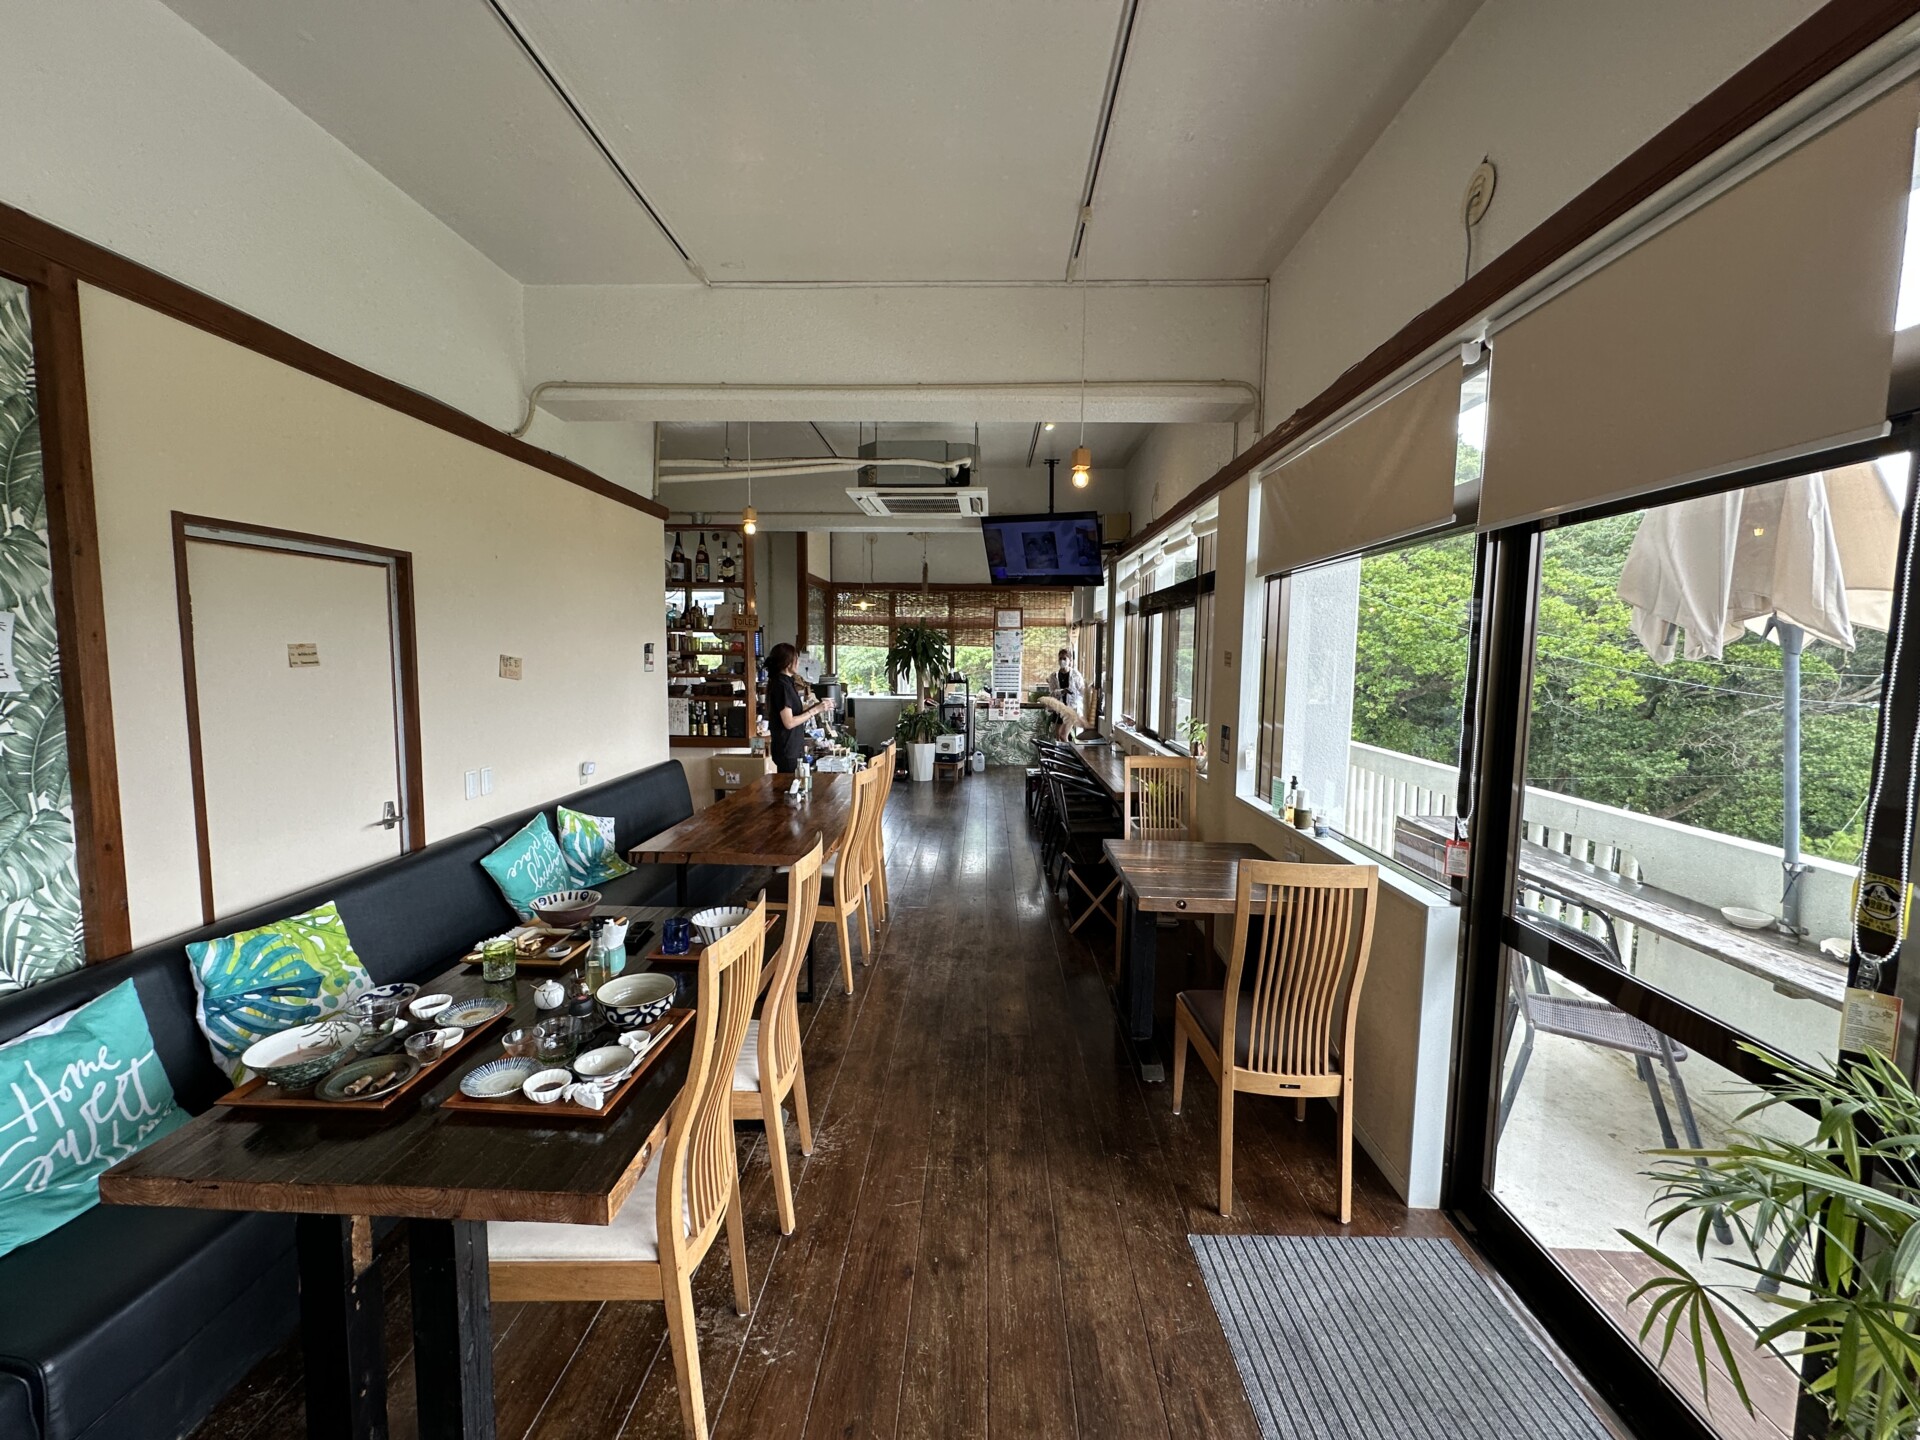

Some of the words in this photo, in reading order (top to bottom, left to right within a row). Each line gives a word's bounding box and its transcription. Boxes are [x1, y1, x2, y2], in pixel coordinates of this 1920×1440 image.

[732, 617, 757, 628] TOILET
[506, 831, 542, 880] place
[0, 1045, 122, 1134] Home
